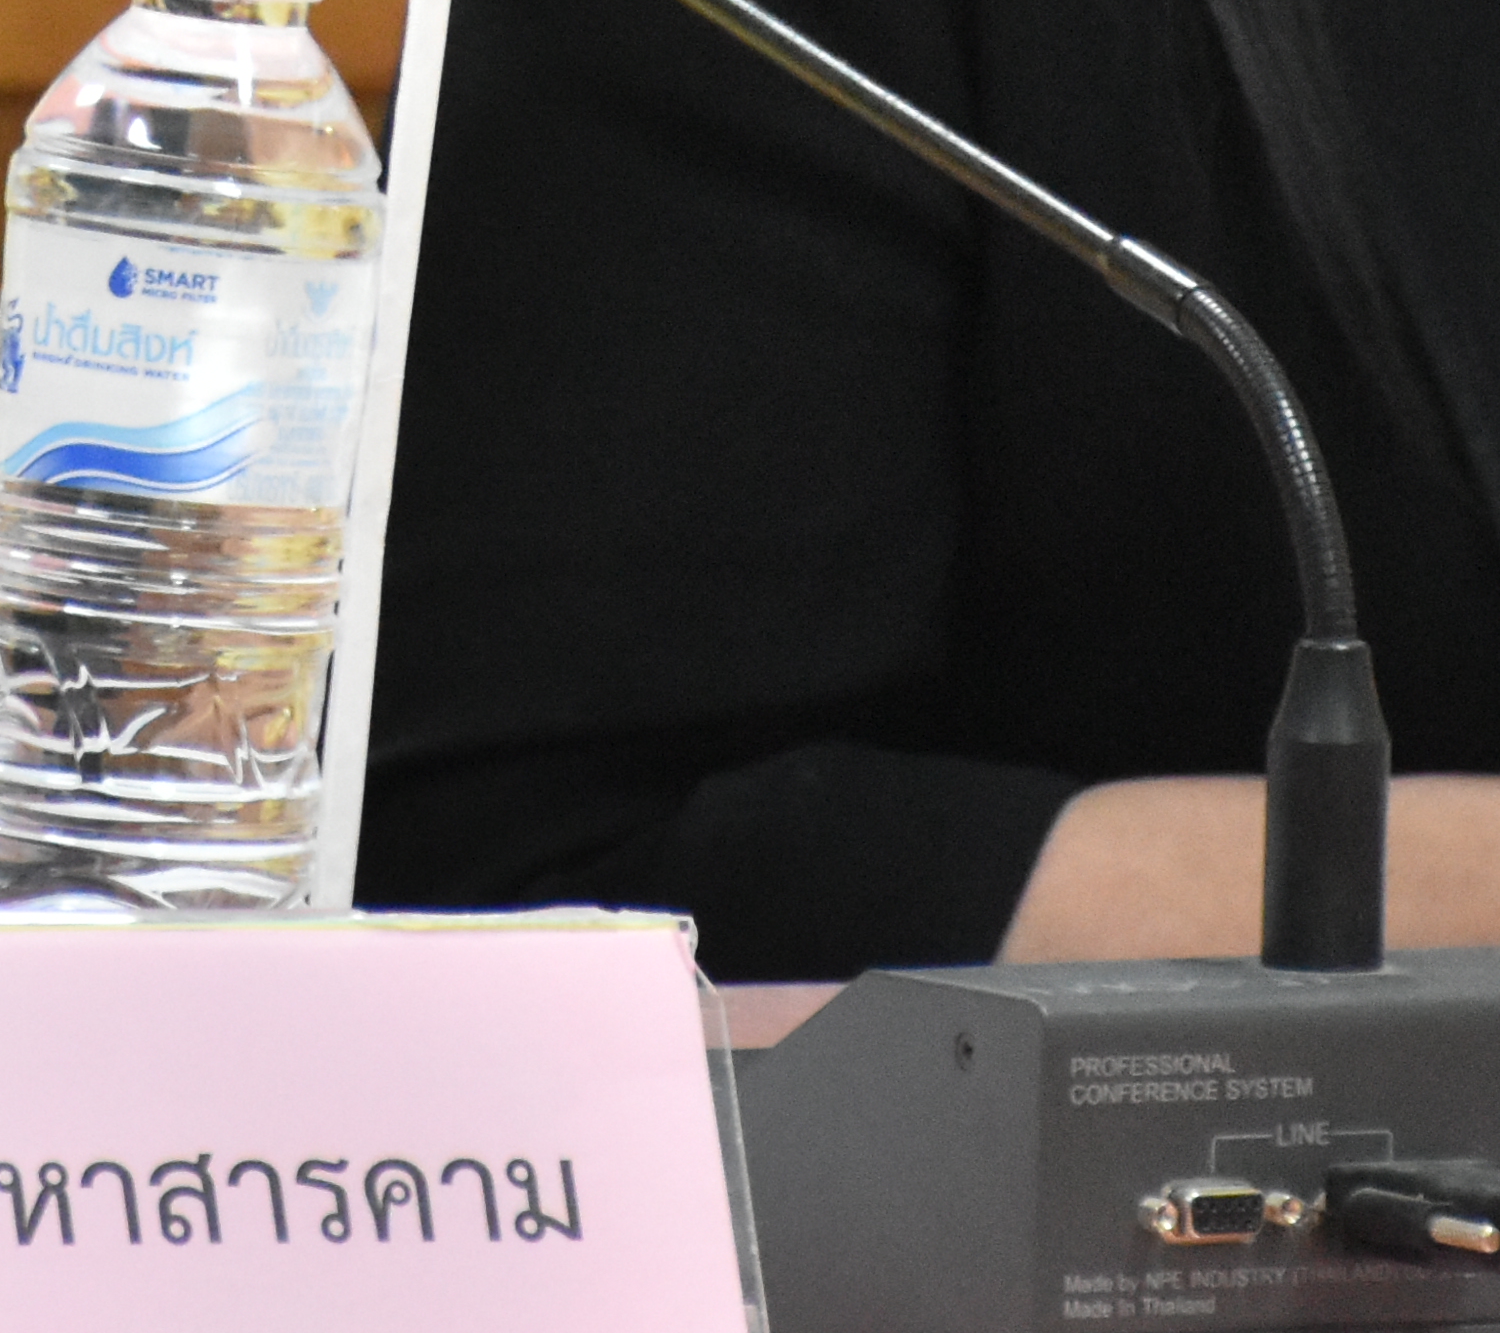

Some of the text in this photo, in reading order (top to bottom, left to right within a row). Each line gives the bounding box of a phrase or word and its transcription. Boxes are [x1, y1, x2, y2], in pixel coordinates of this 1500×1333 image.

[144, 268, 220, 291] SMART
[1070, 1053, 1236, 1078] PROFESSIONAL
[1070, 1077, 1313, 1106] CONFERENCE SYSTEM
[1275, 1121, 1331, 1147] LINE
